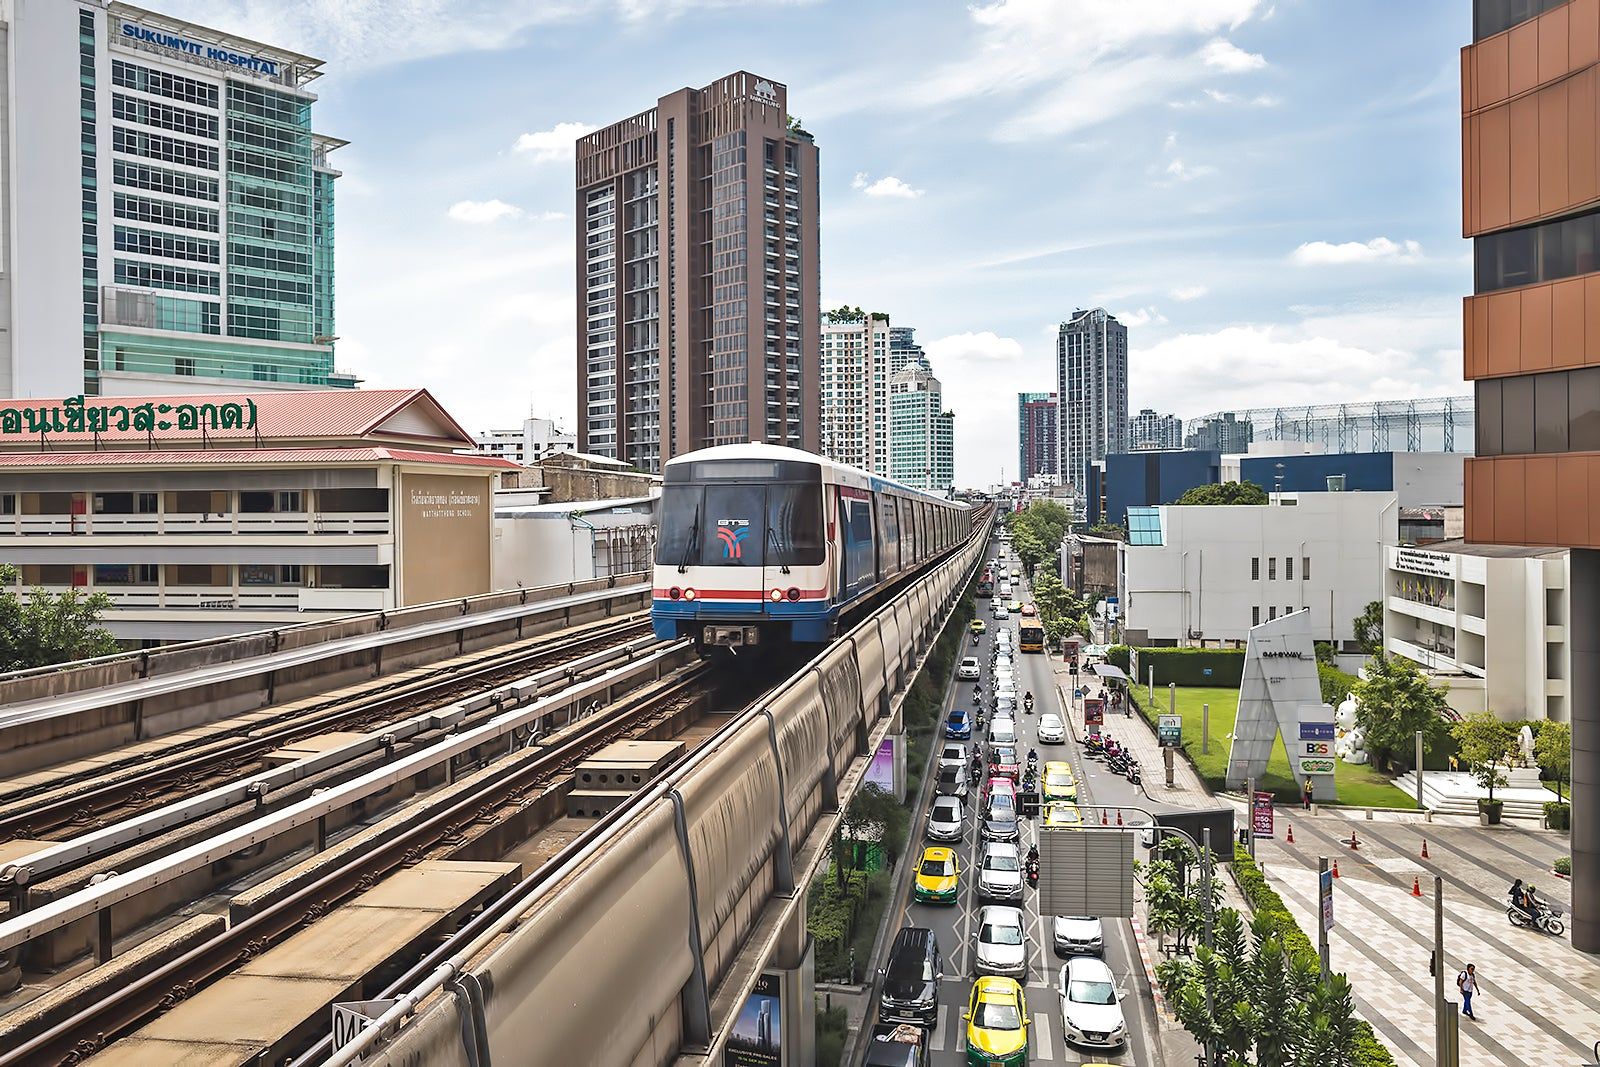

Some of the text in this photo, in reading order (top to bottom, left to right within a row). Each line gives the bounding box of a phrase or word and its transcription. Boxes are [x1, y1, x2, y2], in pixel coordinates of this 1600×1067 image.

[123, 24, 279, 77] SUKUMVIT HOSPITAL
[1306, 743, 1329, 754] B2S
